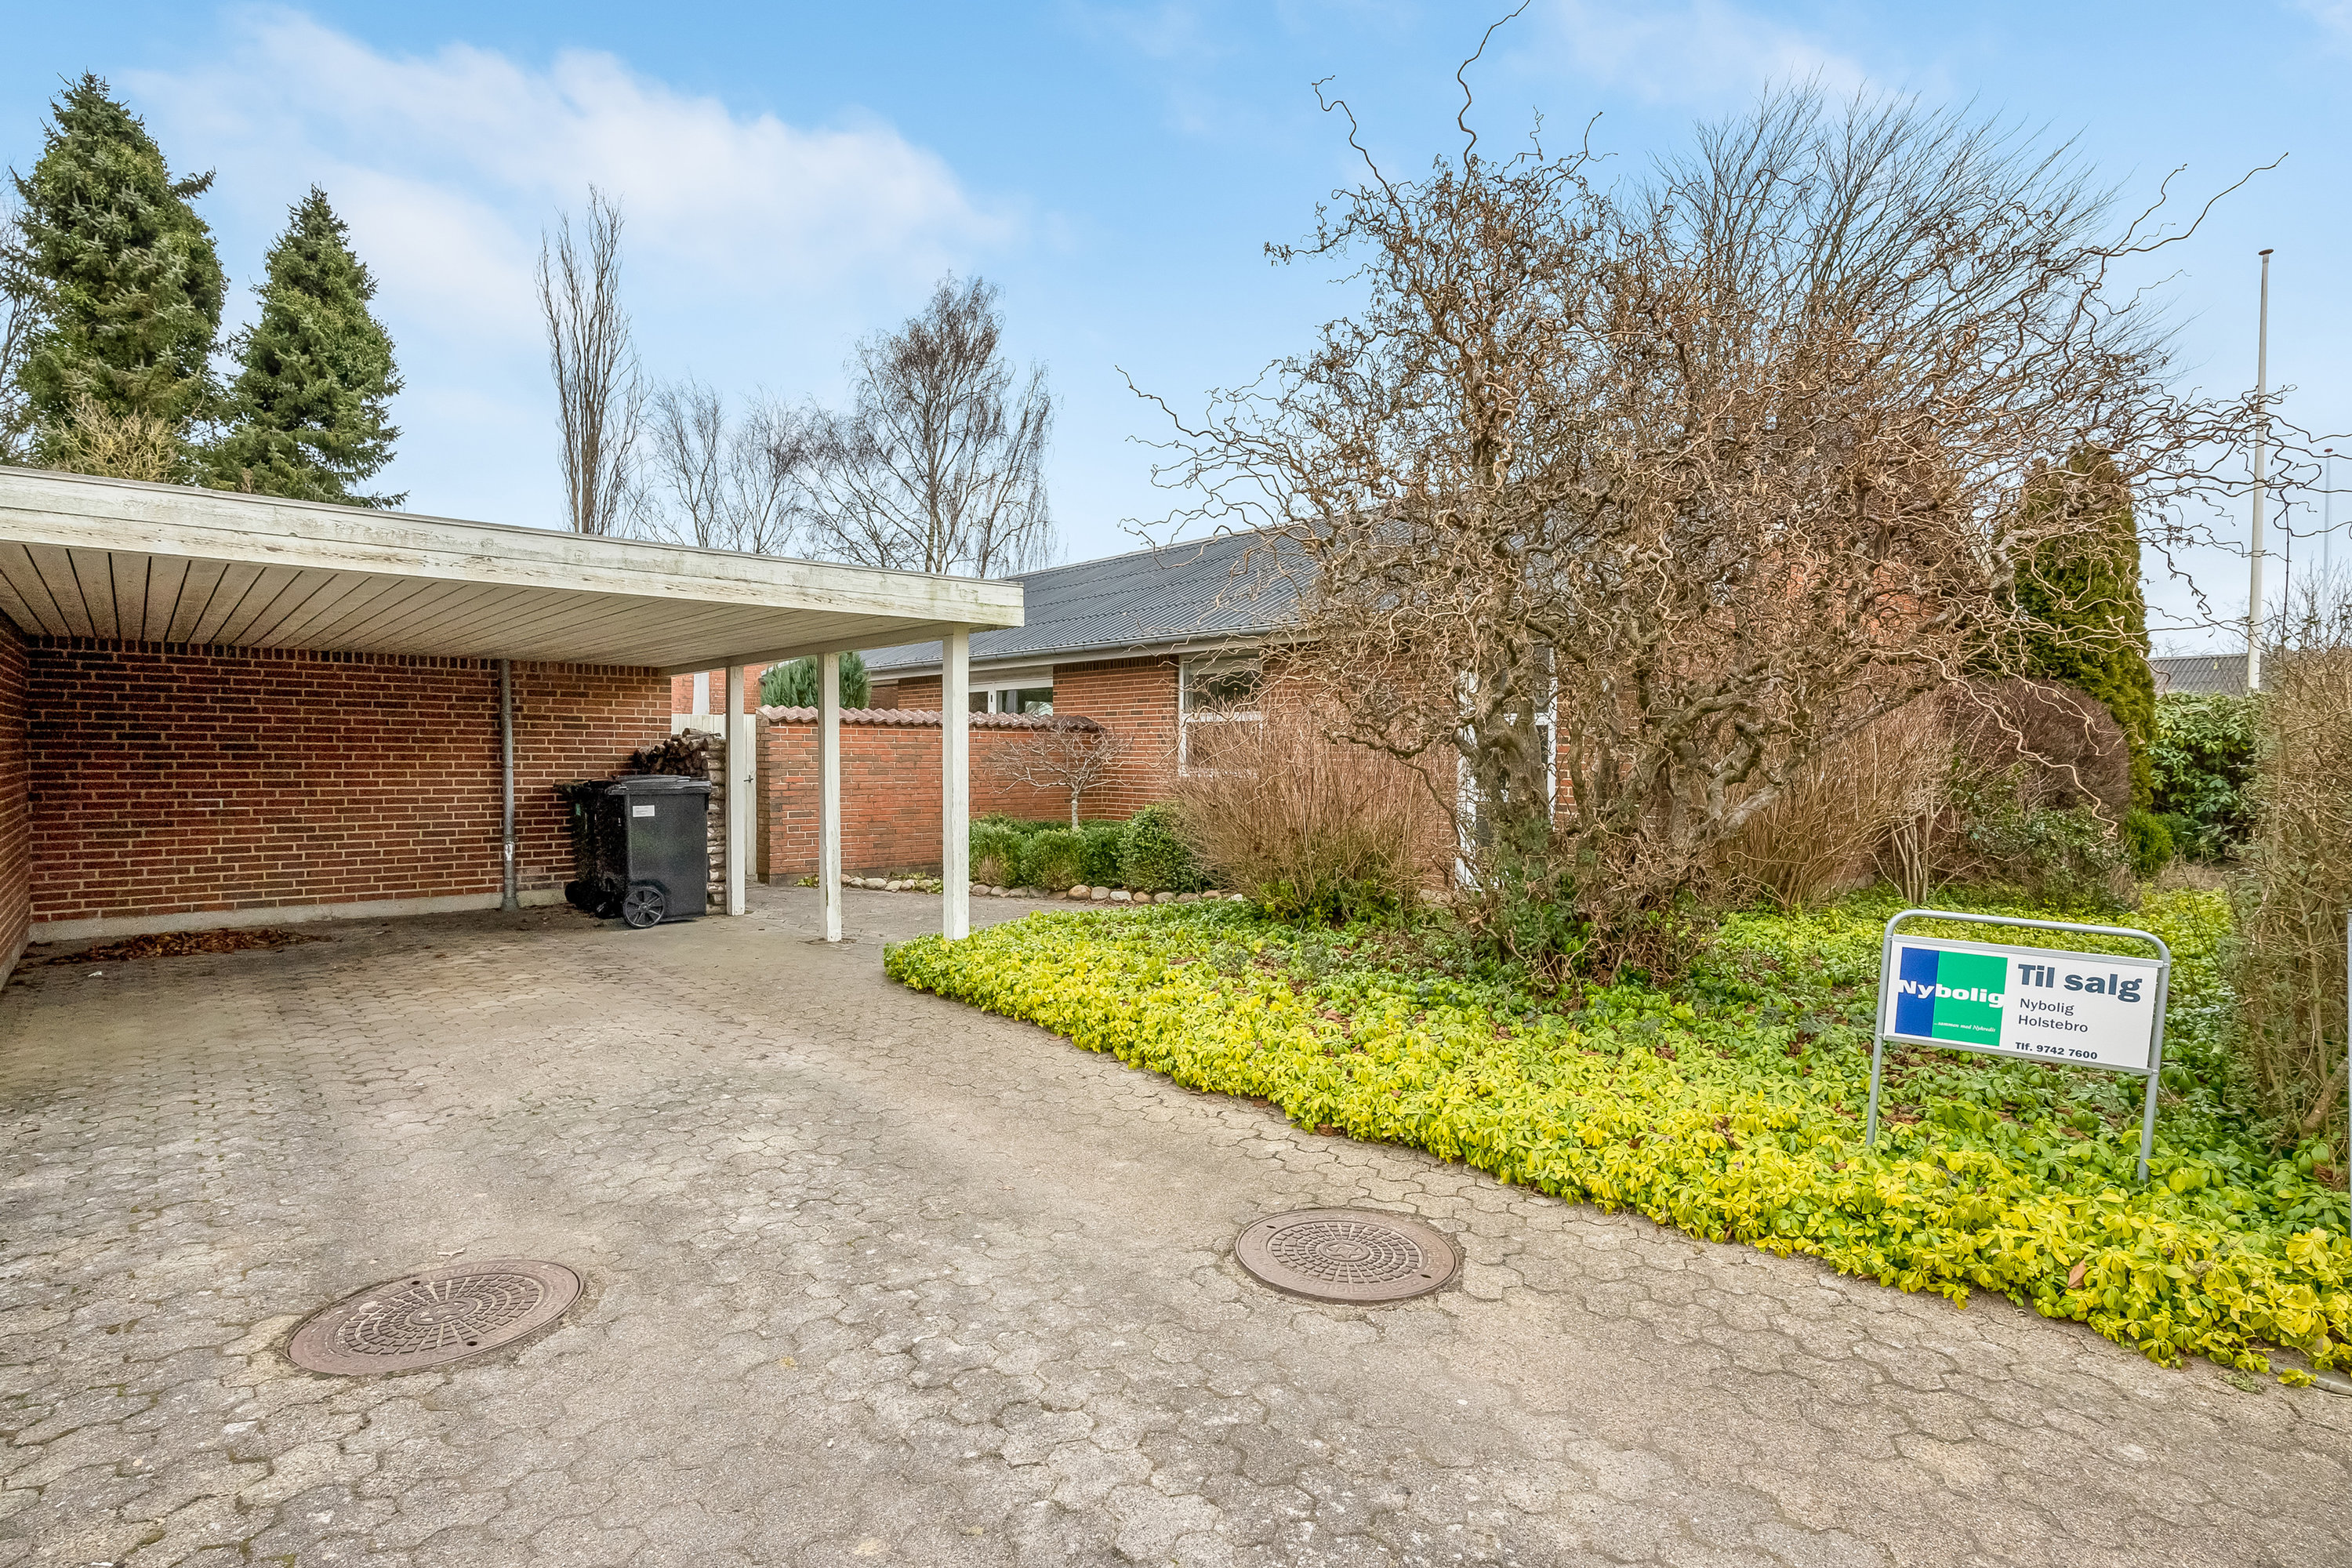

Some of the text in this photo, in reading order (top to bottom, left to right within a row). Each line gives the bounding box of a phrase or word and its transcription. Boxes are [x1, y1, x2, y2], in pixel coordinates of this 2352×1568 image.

[2018, 964, 2143, 1003] Til salg
[1898, 979, 2004, 1008] Nybolig
[2020, 998, 2074, 1016] Nybolig
[2019, 1014, 2089, 1033] Holstebro
[2016, 1042, 2098, 1060] Tlf. 9742 7600
